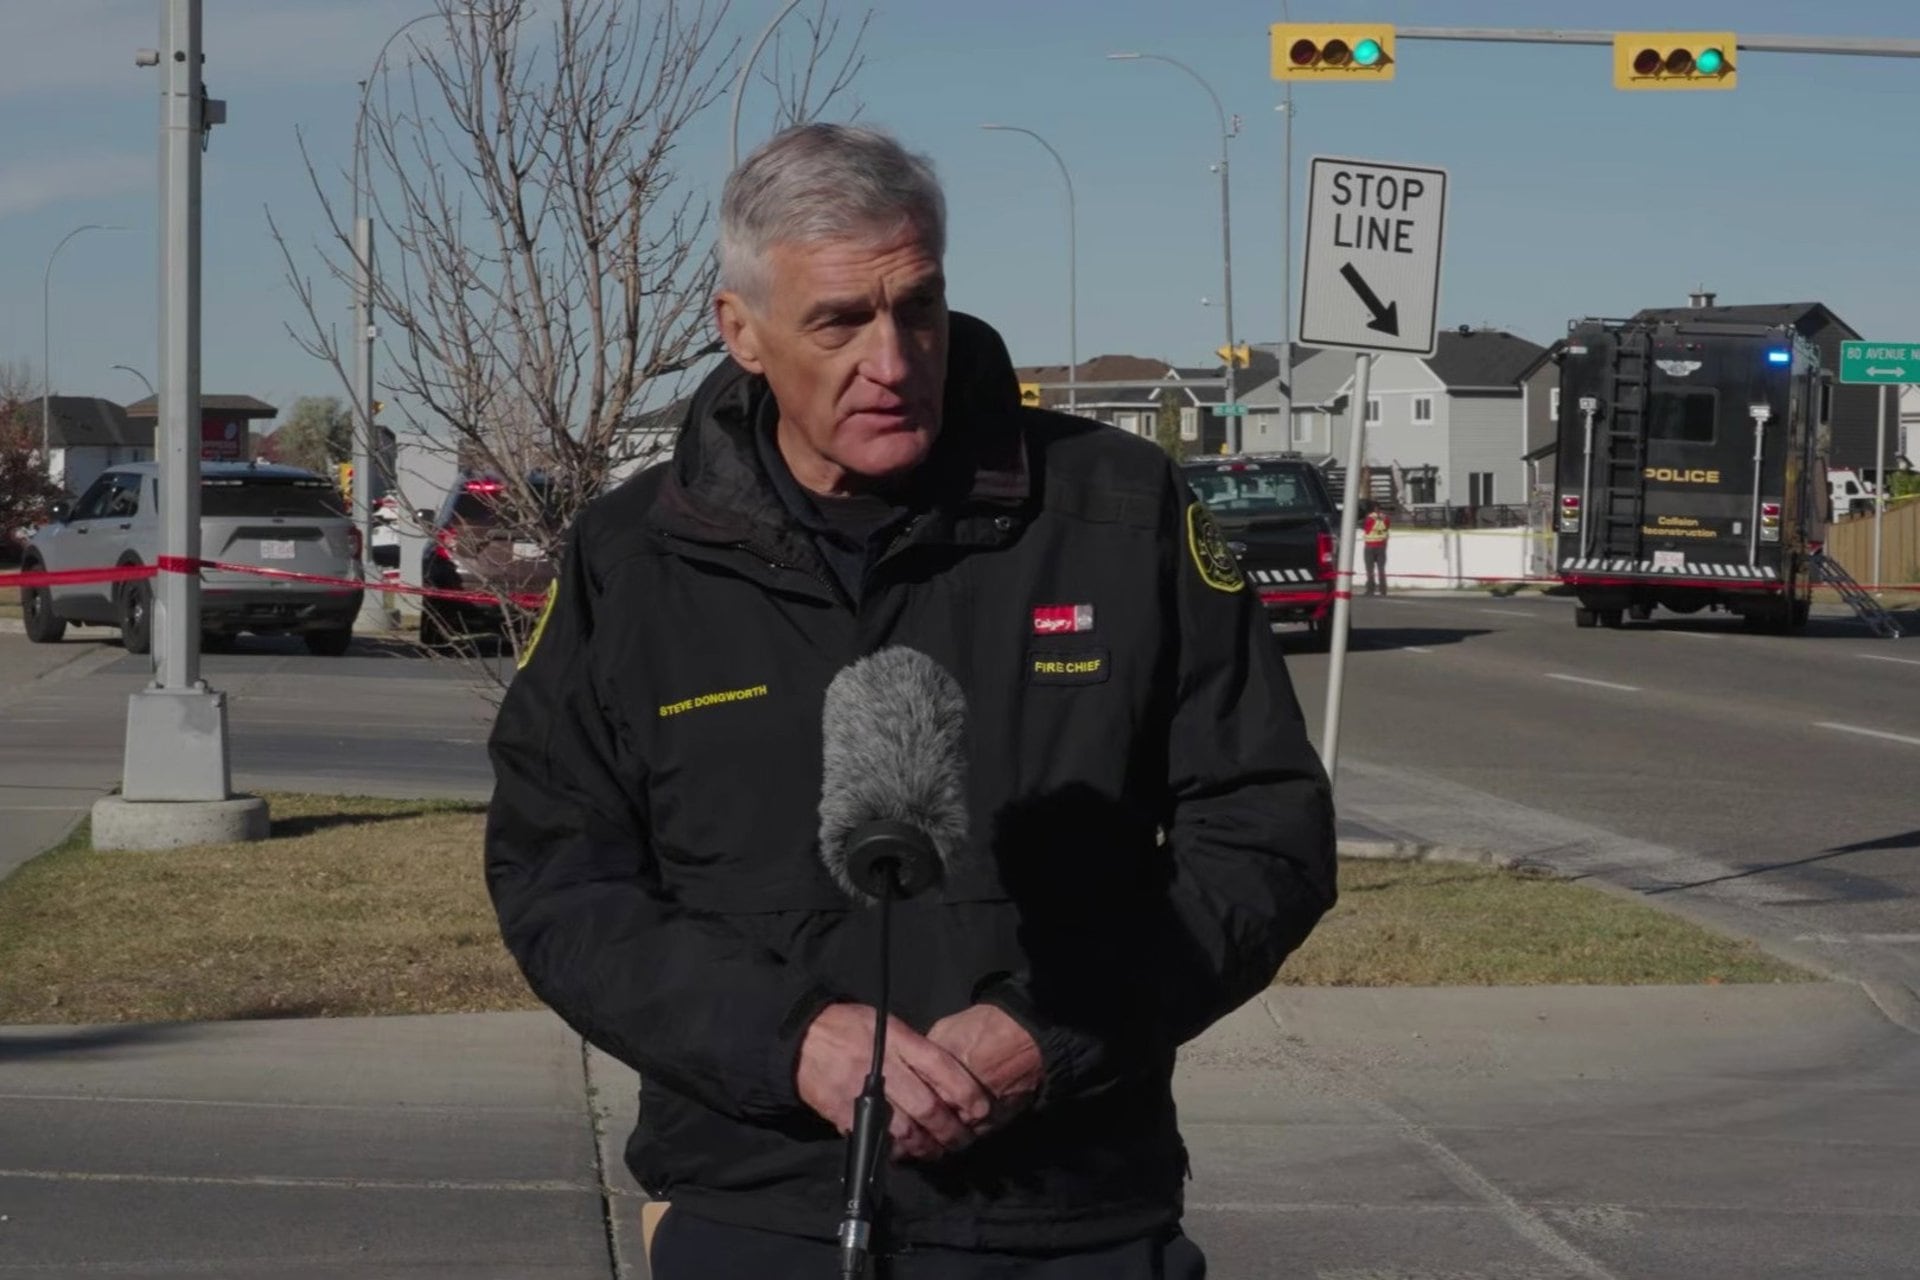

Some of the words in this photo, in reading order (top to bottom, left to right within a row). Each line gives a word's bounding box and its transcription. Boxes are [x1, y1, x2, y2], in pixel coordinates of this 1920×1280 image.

[1331, 170, 1425, 212] STOP
[1333, 213, 1415, 254] LINE
[1865, 348, 1907, 361] AVENUE
[1645, 468, 1720, 484] POLICE
[1657, 516, 1699, 526] Collision
[1034, 618, 1072, 631] Calgary
[1034, 661, 1064, 673] FIRE
[1066, 659, 1102, 673] CHIEF
[659, 699, 693, 717] STEVE
[694, 685, 768, 707] DONGWORTH
